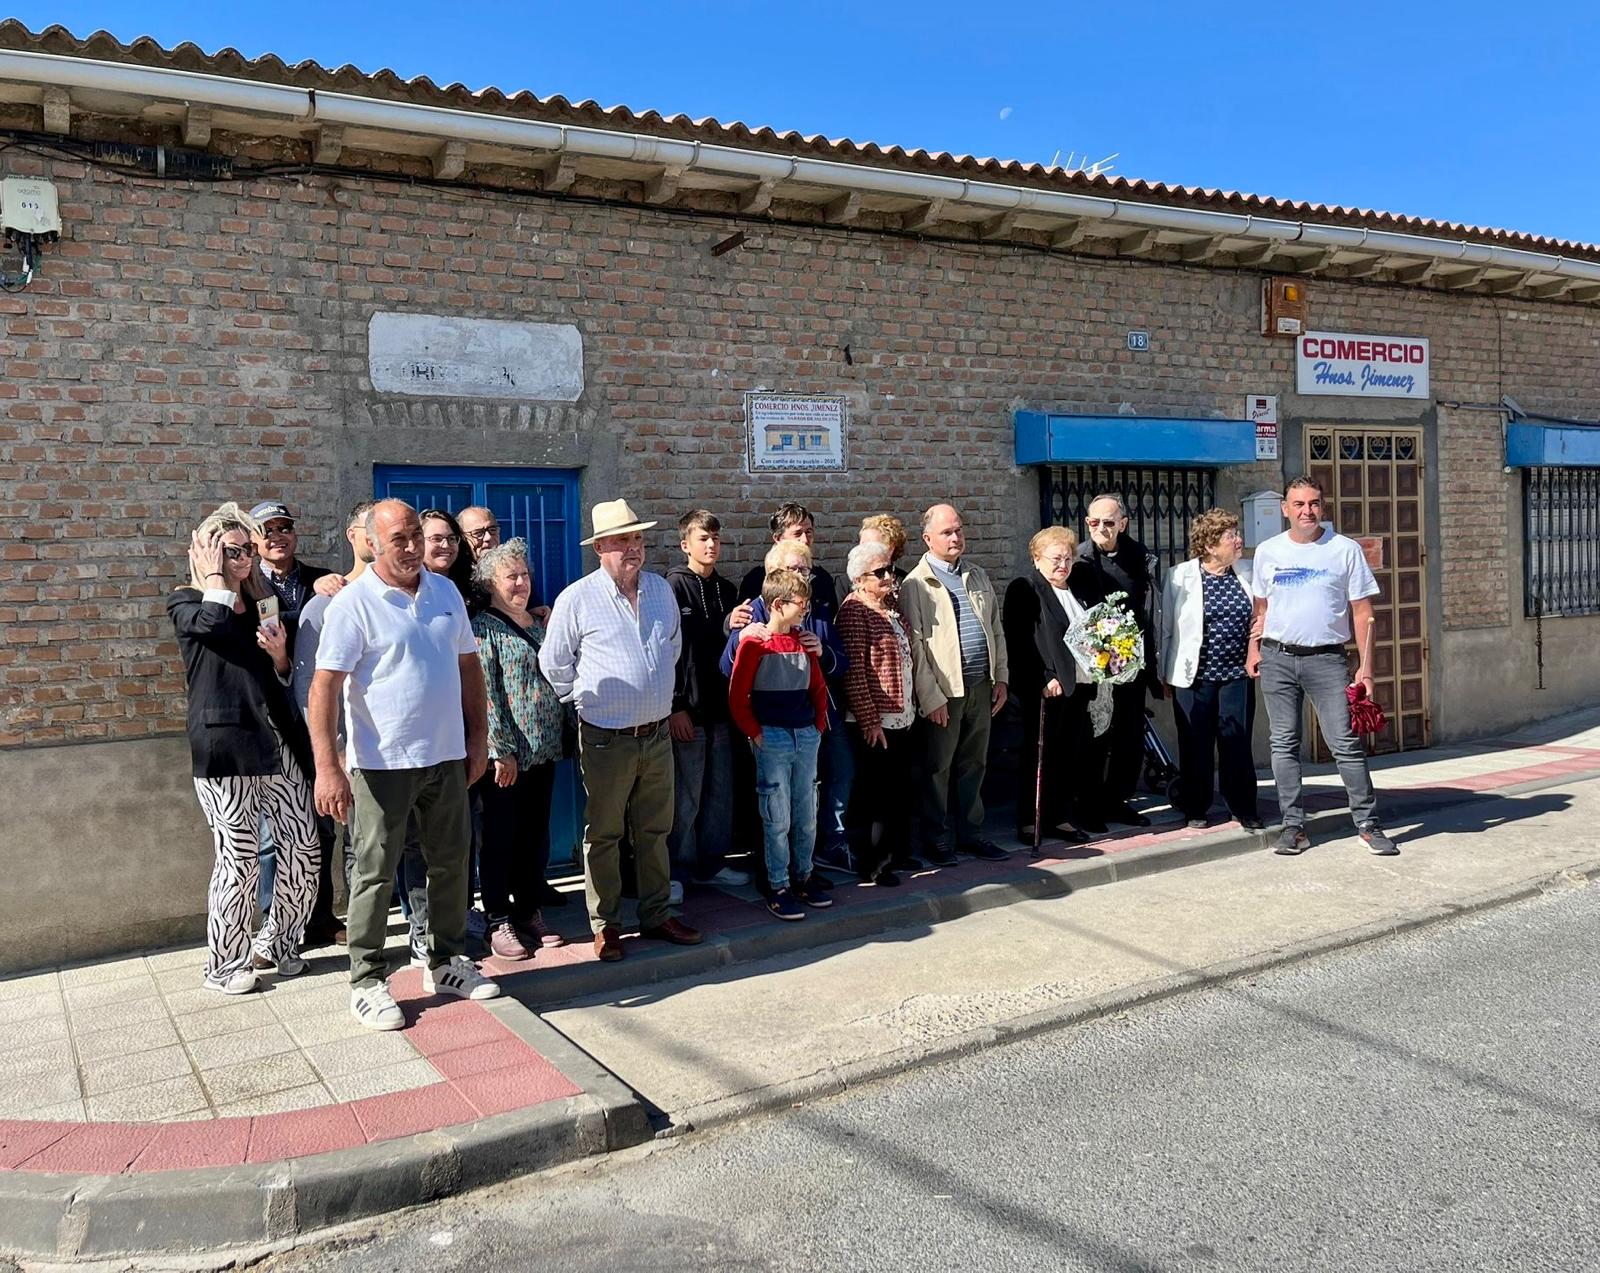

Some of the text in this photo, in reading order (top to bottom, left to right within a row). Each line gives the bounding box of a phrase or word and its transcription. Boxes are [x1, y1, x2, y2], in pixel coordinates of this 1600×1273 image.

[1132, 335, 1144, 347] 18
[1303, 338, 1424, 364] COMERCIO
[1313, 361, 1416, 394] Hnos. Jimenez
[754, 402, 838, 412] COMERCIO HNOS JIMENEZ
[1256, 425, 1276, 433] arma
